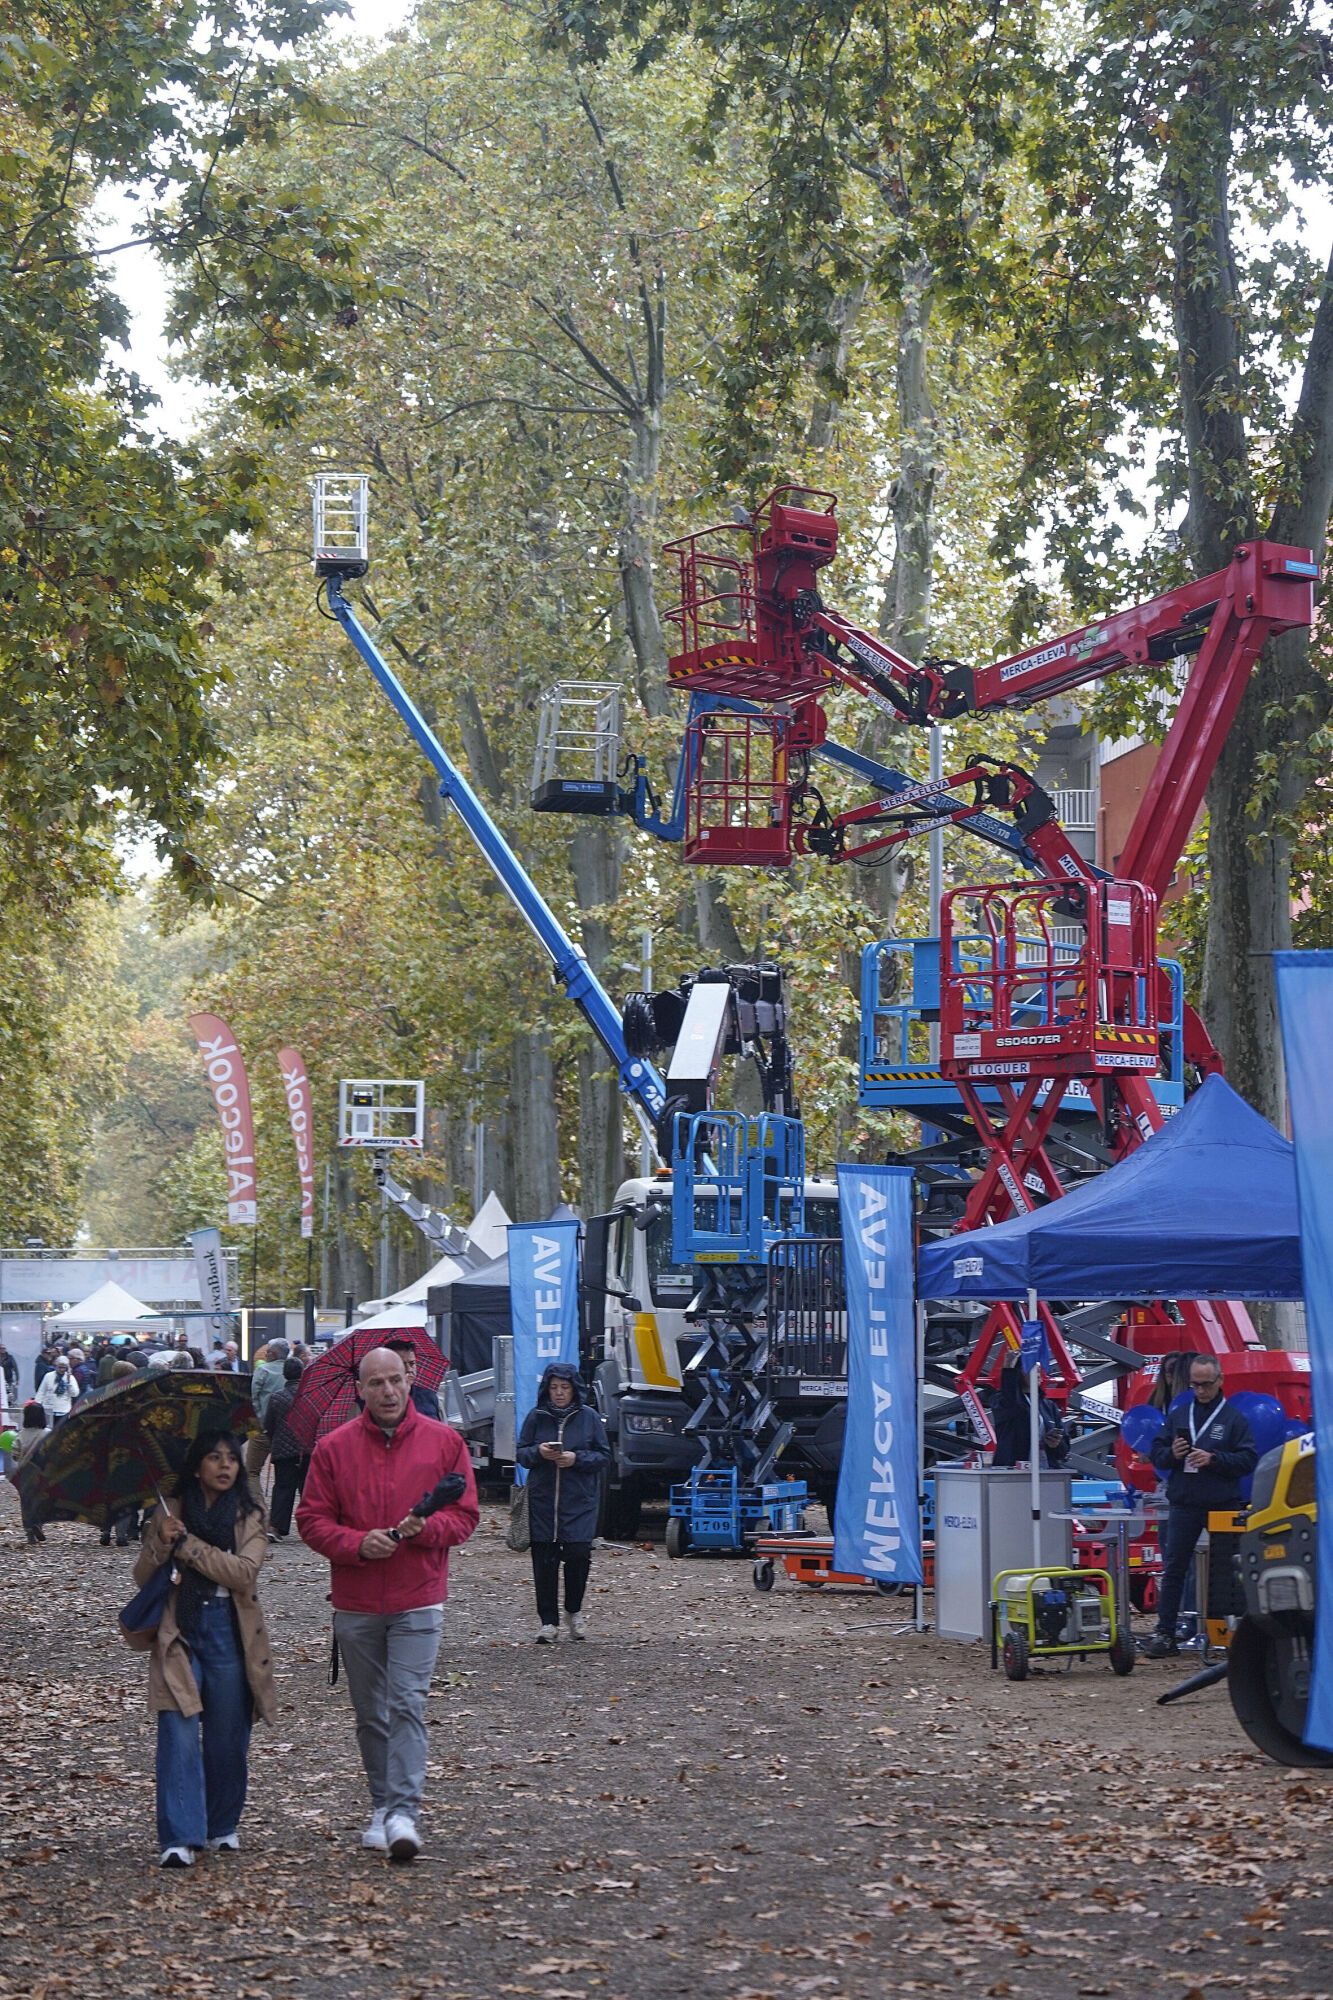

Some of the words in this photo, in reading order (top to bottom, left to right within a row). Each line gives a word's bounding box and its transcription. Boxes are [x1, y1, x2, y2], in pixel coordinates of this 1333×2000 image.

[1001, 645, 1066, 679] MERCA-ELEVA
[880, 779, 949, 810] MERCA-ELEVA
[1096, 1055, 1155, 1066] MERCA-ELEVA
[970, 1063, 1028, 1075] LLOGUER
[694, 1521, 731, 1532] 1709
